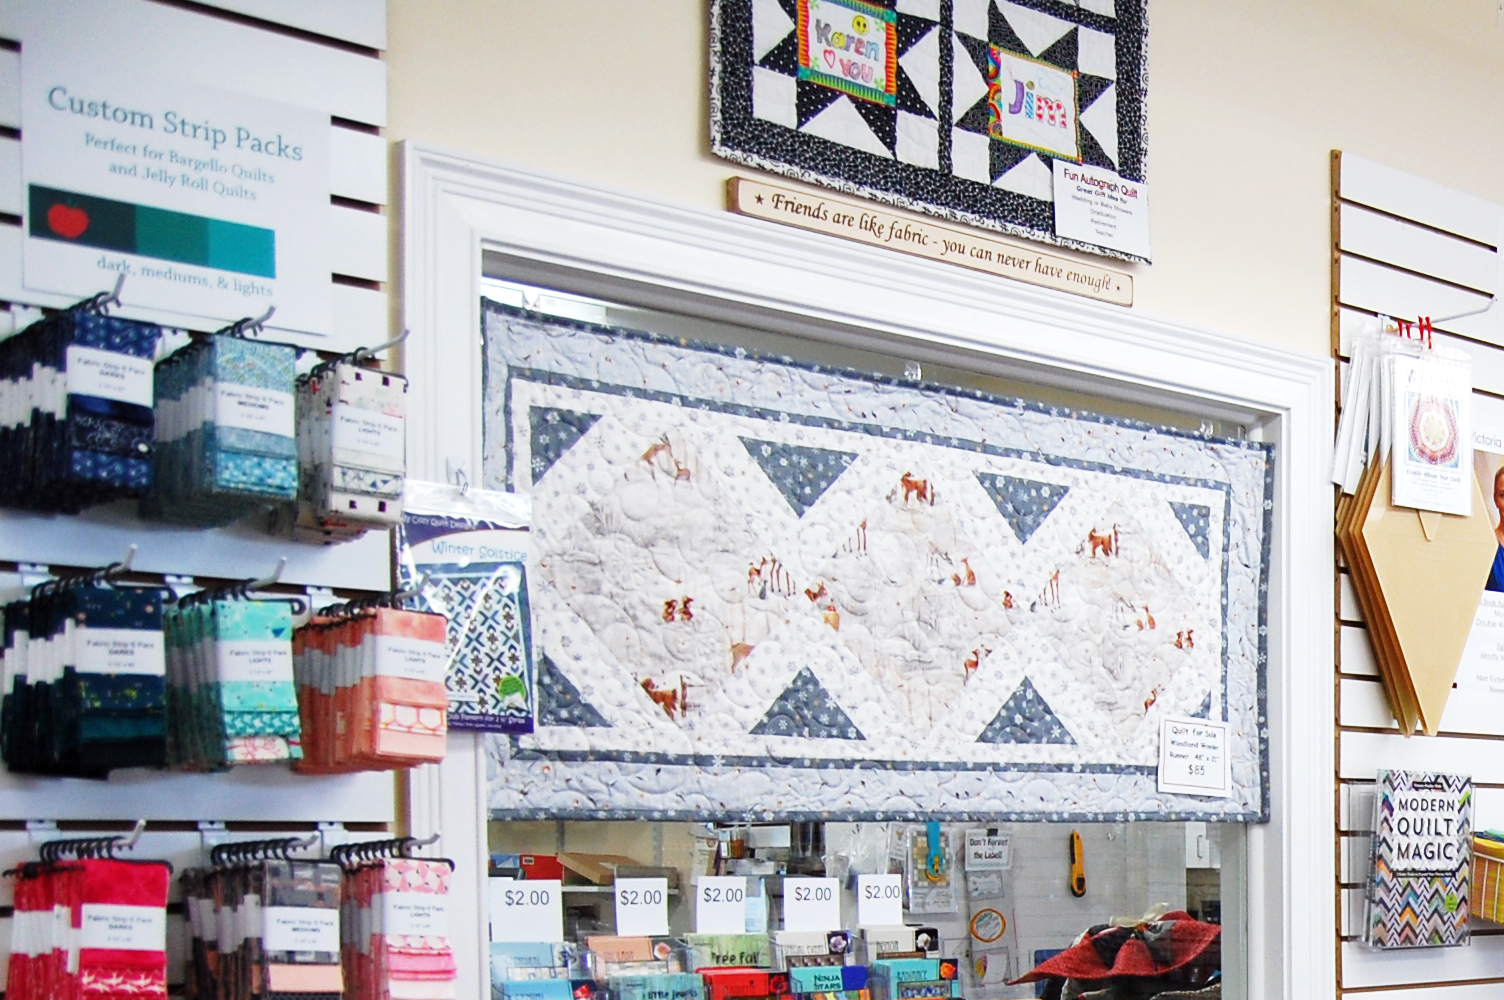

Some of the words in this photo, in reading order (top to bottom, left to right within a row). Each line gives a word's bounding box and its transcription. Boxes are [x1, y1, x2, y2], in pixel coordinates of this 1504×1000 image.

[814, 18, 880, 62] Karen
[47, 85, 154, 130] Custom
[163, 111, 227, 150] Strip
[235, 125, 304, 162] Packs
[83, 132, 138, 156] Perfect
[142, 144, 165, 162] for
[169, 149, 227, 175] Bargello
[231, 163, 275, 184] Quilts
[108, 162, 138, 178] and
[141, 166, 177, 189] Jelly
[180, 174, 209, 193] Roll
[212, 181, 257, 201] Quilts
[1063, 168, 1079, 182] Fun
[1080, 173, 1120, 194] Autograph
[770, 192, 829, 222] Friends
[831, 210, 856, 228] are
[858, 213, 886, 239] like
[886, 220, 930, 247] fabric
[940, 237, 967, 257] you
[969, 244, 994, 263] can
[996, 251, 1031, 272] never
[1033, 256, 1064, 281] have
[1065, 267, 1112, 294] enough!
[96, 256, 136, 276] dark,
[140, 266, 214, 289] mediums,
[216, 276, 230, 290] &
[233, 278, 274, 298] lights
[1471, 430, 1503, 449] ictoria
[431, 539, 475, 556] Winter
[479, 545, 528, 563] Solstice
[1398, 797, 1455, 812] MODERN
[1396, 816, 1454, 838] QUILT
[969, 837, 986, 848] Don't
[1396, 841, 1455, 861] MAGIC
[973, 850, 984, 860] the
[504, 889, 550, 907] $2.00
[619, 889, 663, 906] $2.00
[703, 887, 743, 904] $2.00
[794, 886, 833, 902] $2.00
[864, 883, 901, 900] $2.00
